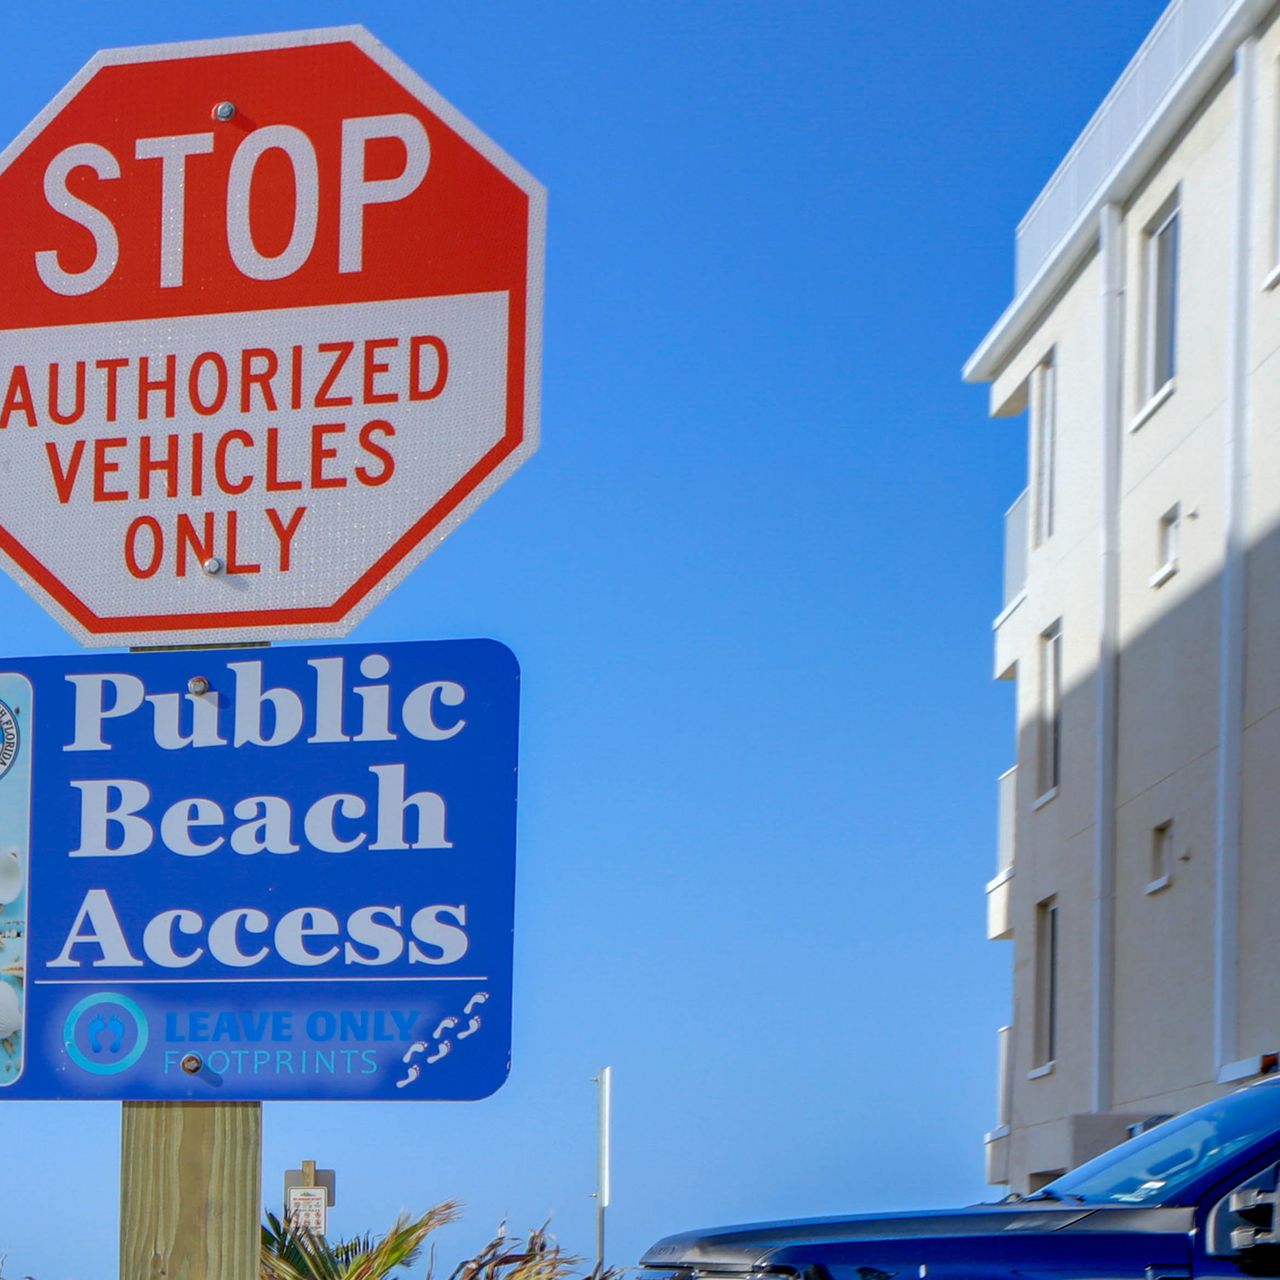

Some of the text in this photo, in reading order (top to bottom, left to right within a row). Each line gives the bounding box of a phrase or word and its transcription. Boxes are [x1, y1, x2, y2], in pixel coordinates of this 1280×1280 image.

[35, 113, 431, 296] STOP
[45, 420, 397, 504] VEHICLES
[124, 506, 307, 580] ONLY
[62, 654, 467, 752] Public
[68, 763, 453, 858] Beach
[46, 888, 469, 968] Access
[165, 1009, 421, 1042] LEAVE ONLY
